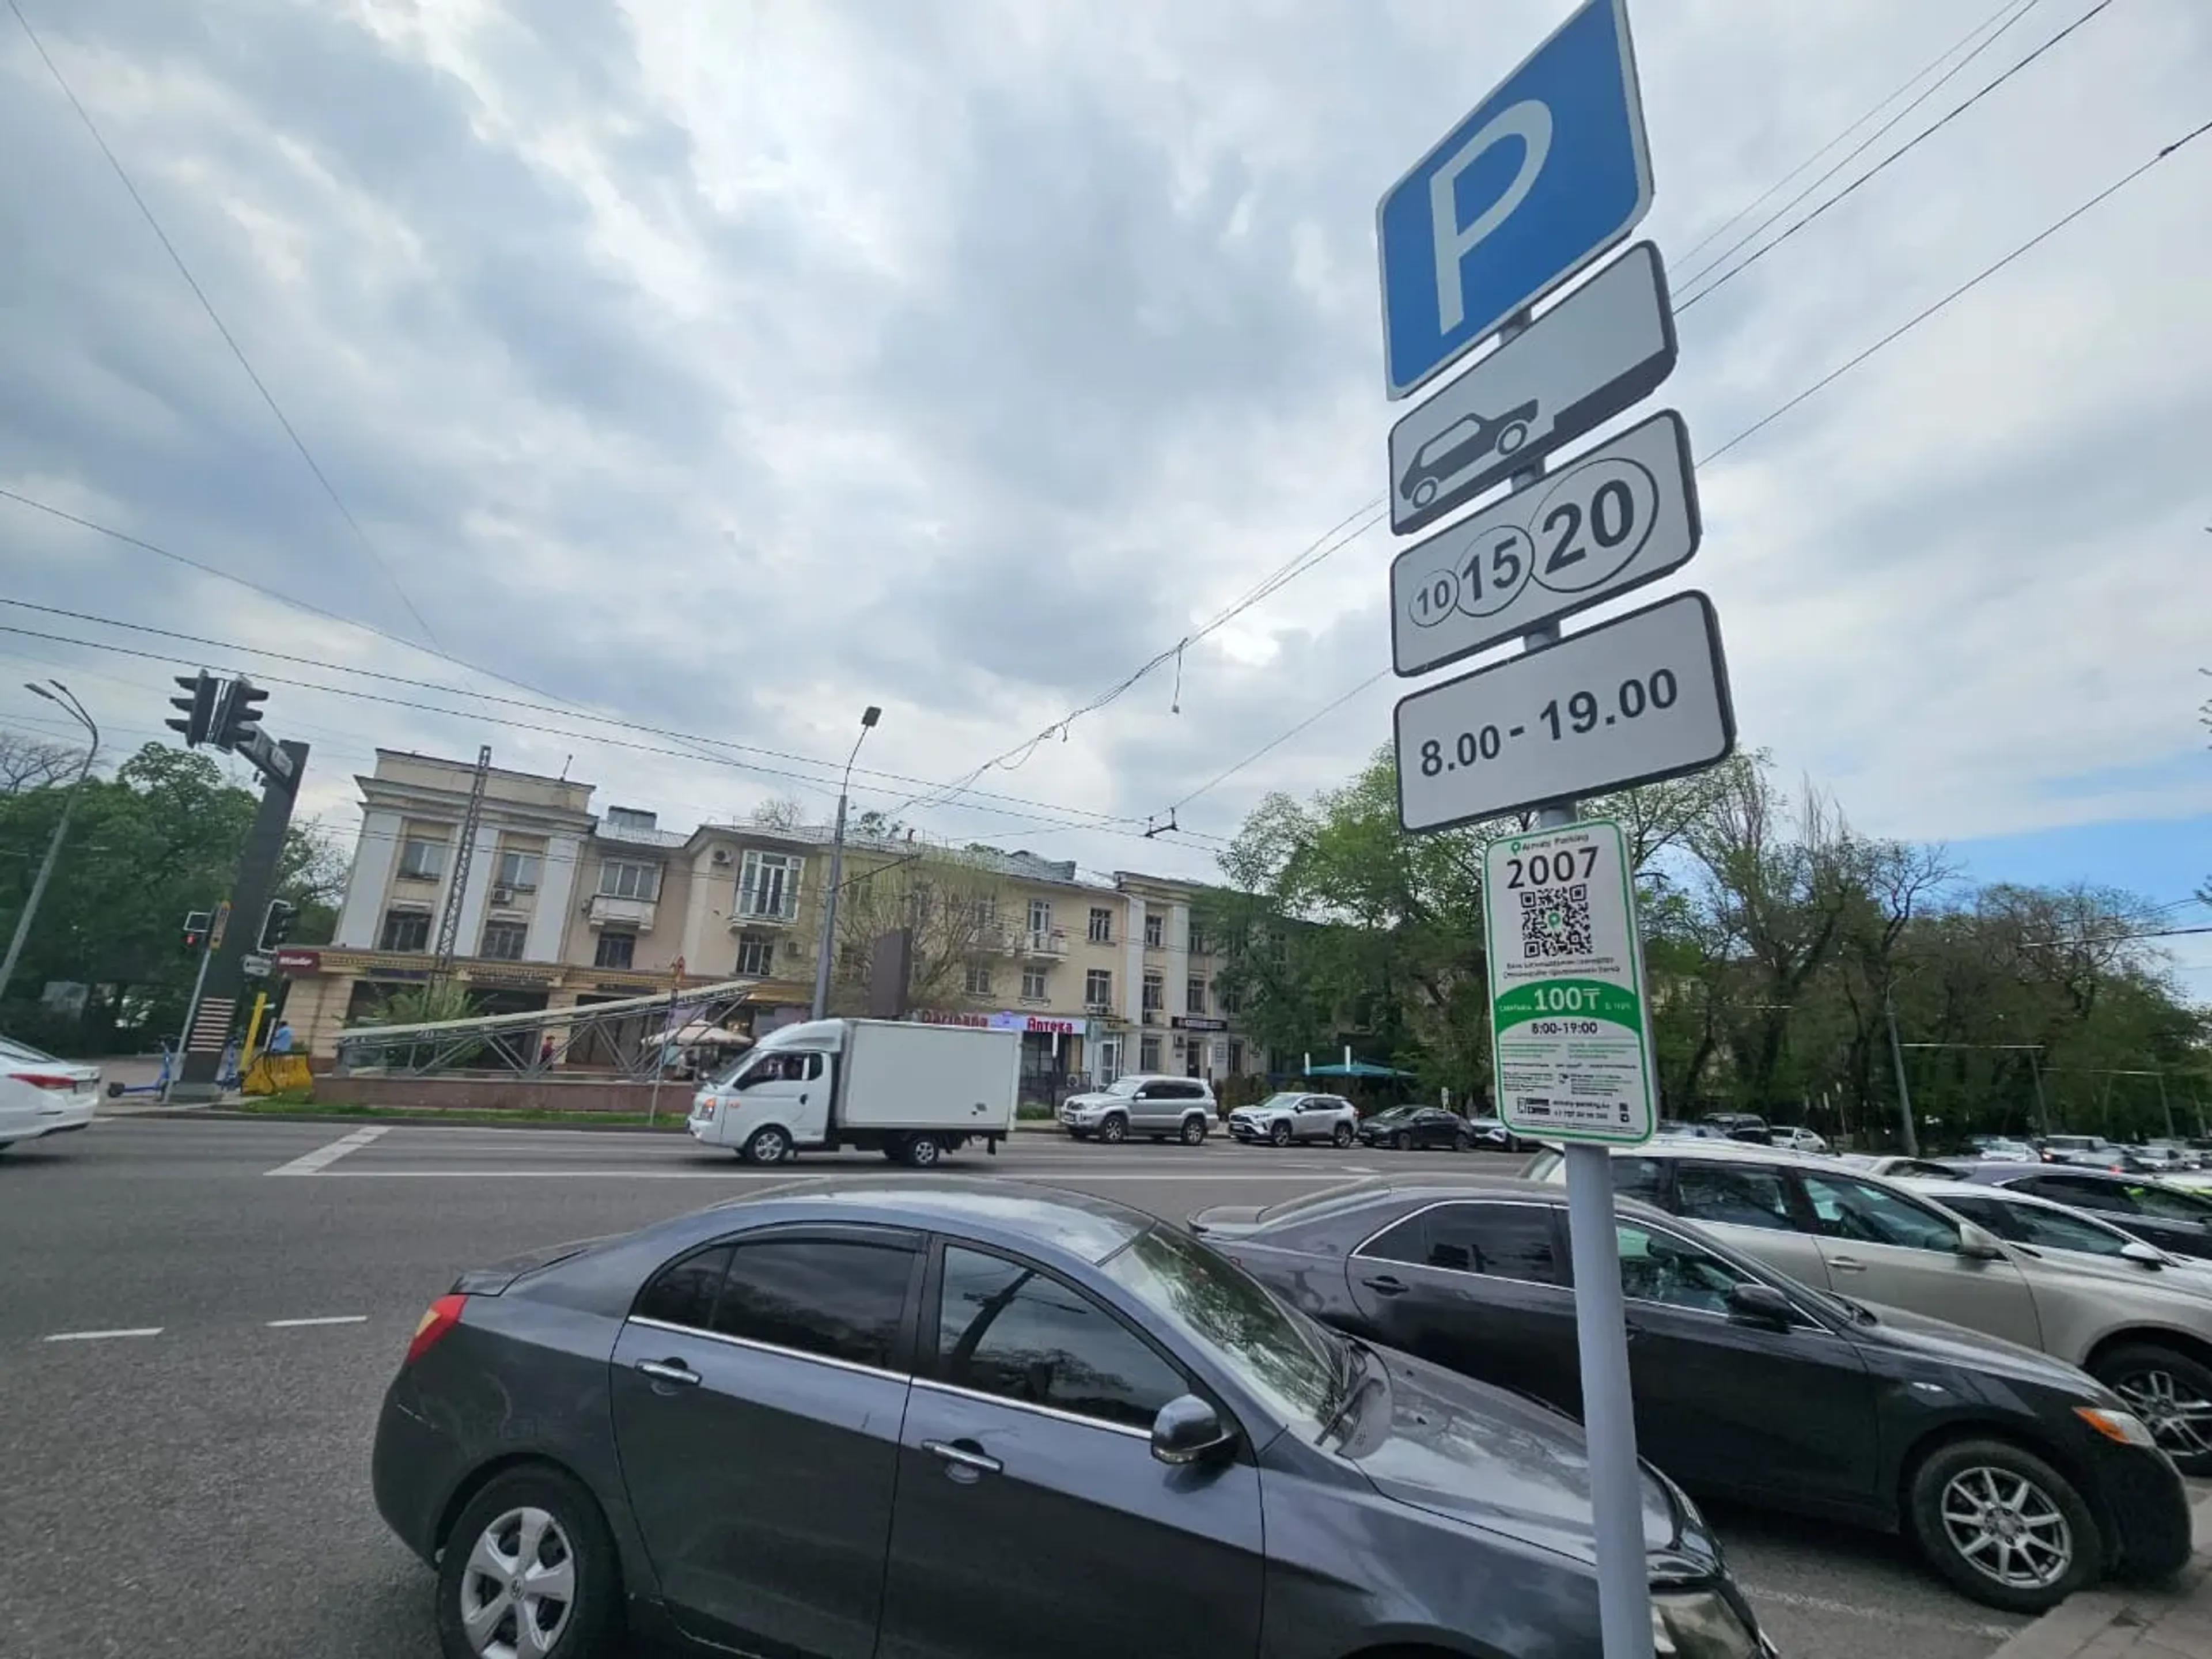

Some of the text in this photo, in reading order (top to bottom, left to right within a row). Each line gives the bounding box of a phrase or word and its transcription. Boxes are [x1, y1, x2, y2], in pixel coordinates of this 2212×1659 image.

[1429, 100, 1552, 335] P
[1417, 480, 1634, 616] 10 15 20
[1507, 845, 1599, 889] 2007
